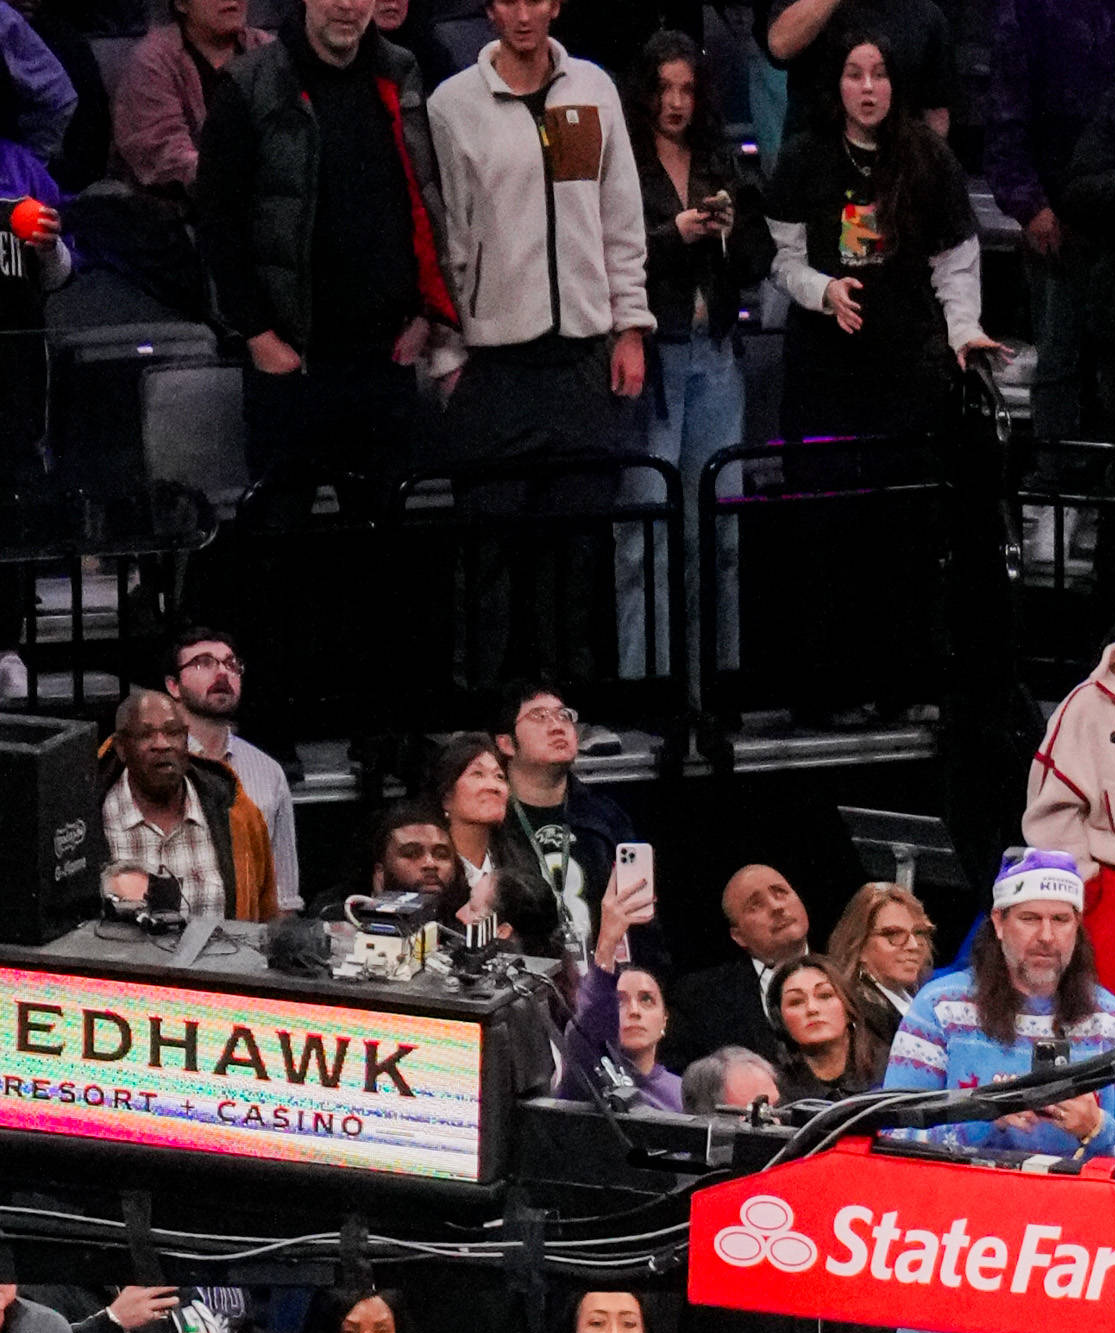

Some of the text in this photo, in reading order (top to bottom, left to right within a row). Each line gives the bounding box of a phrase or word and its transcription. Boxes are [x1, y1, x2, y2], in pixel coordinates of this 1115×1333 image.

[15, 1000, 419, 1098] EDHAWK
[4, 1075, 158, 1113] RESORT
[217, 1100, 364, 1137] CASINO
